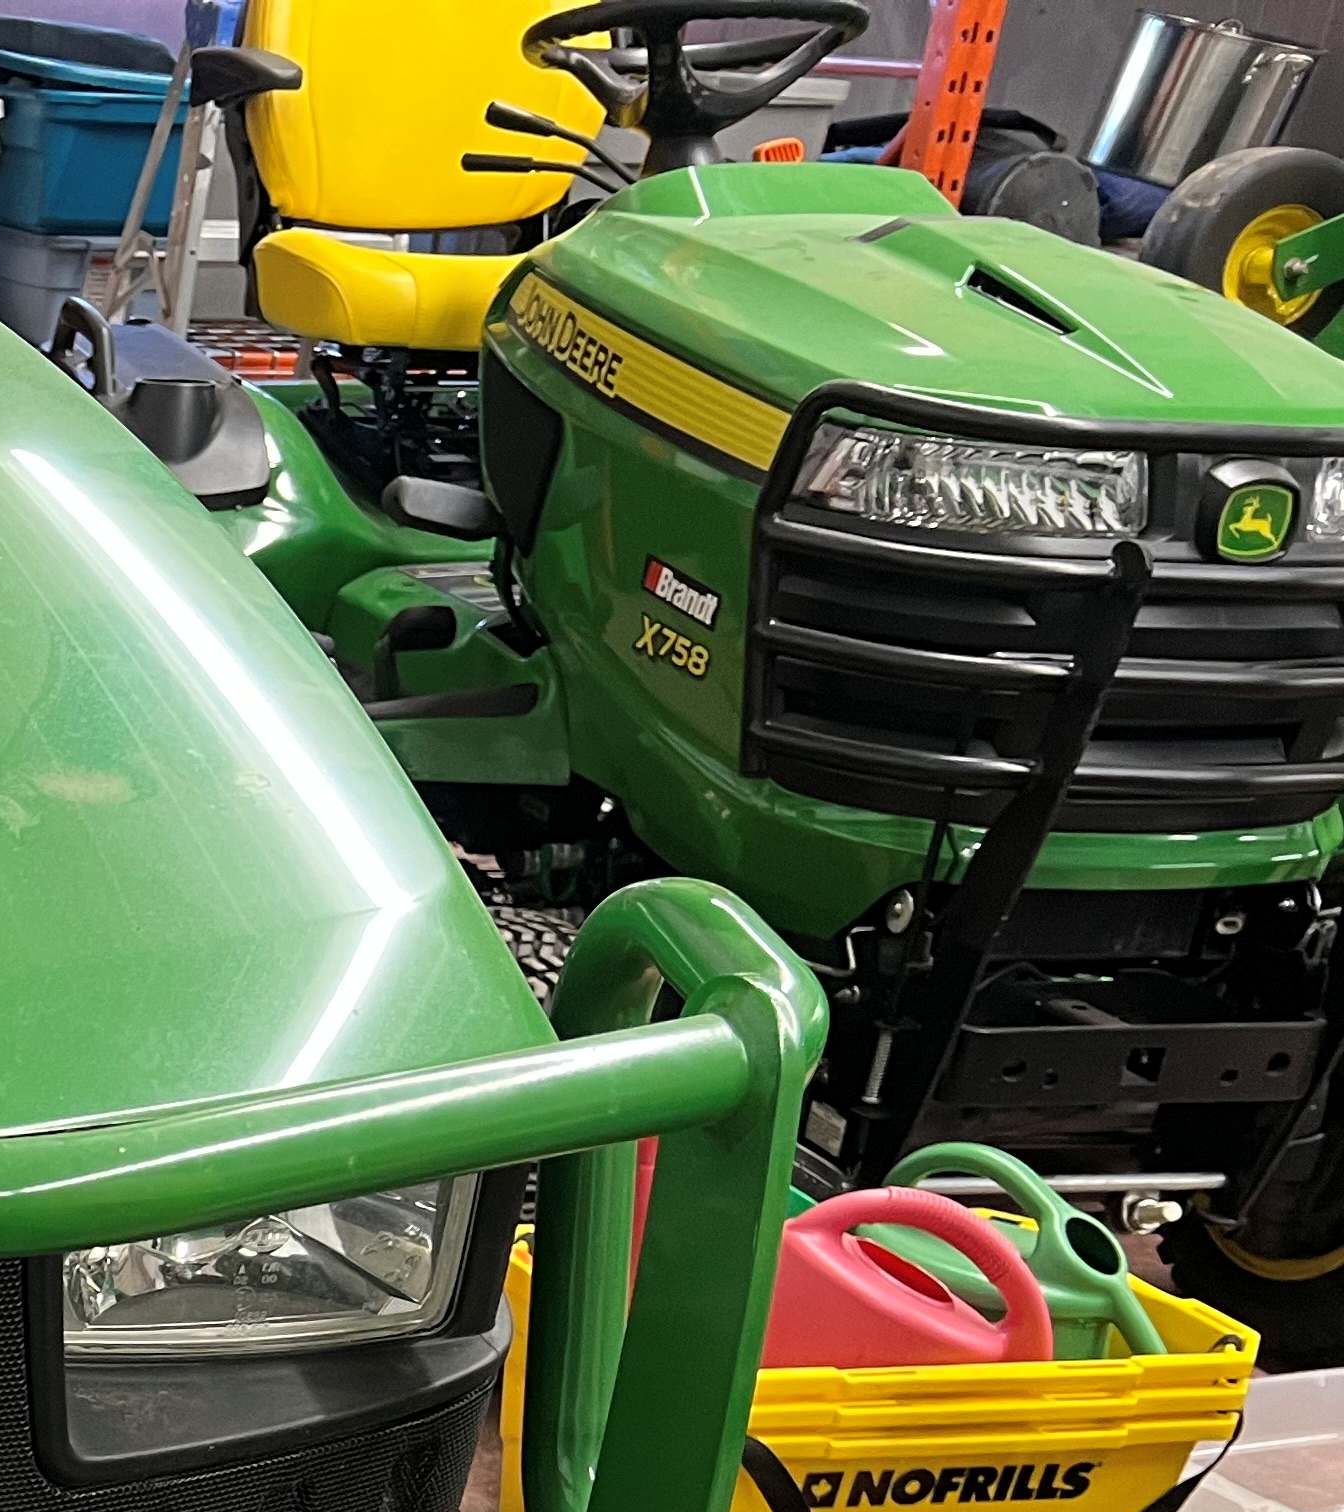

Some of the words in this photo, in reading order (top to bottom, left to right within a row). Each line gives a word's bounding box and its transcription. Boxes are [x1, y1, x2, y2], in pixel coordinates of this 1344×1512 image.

[555, 311, 623, 391] DEERE
[655, 566, 718, 625] Brandt
[635, 615, 709, 676] X758
[846, 1462, 1095, 1507] NOFRILLS
